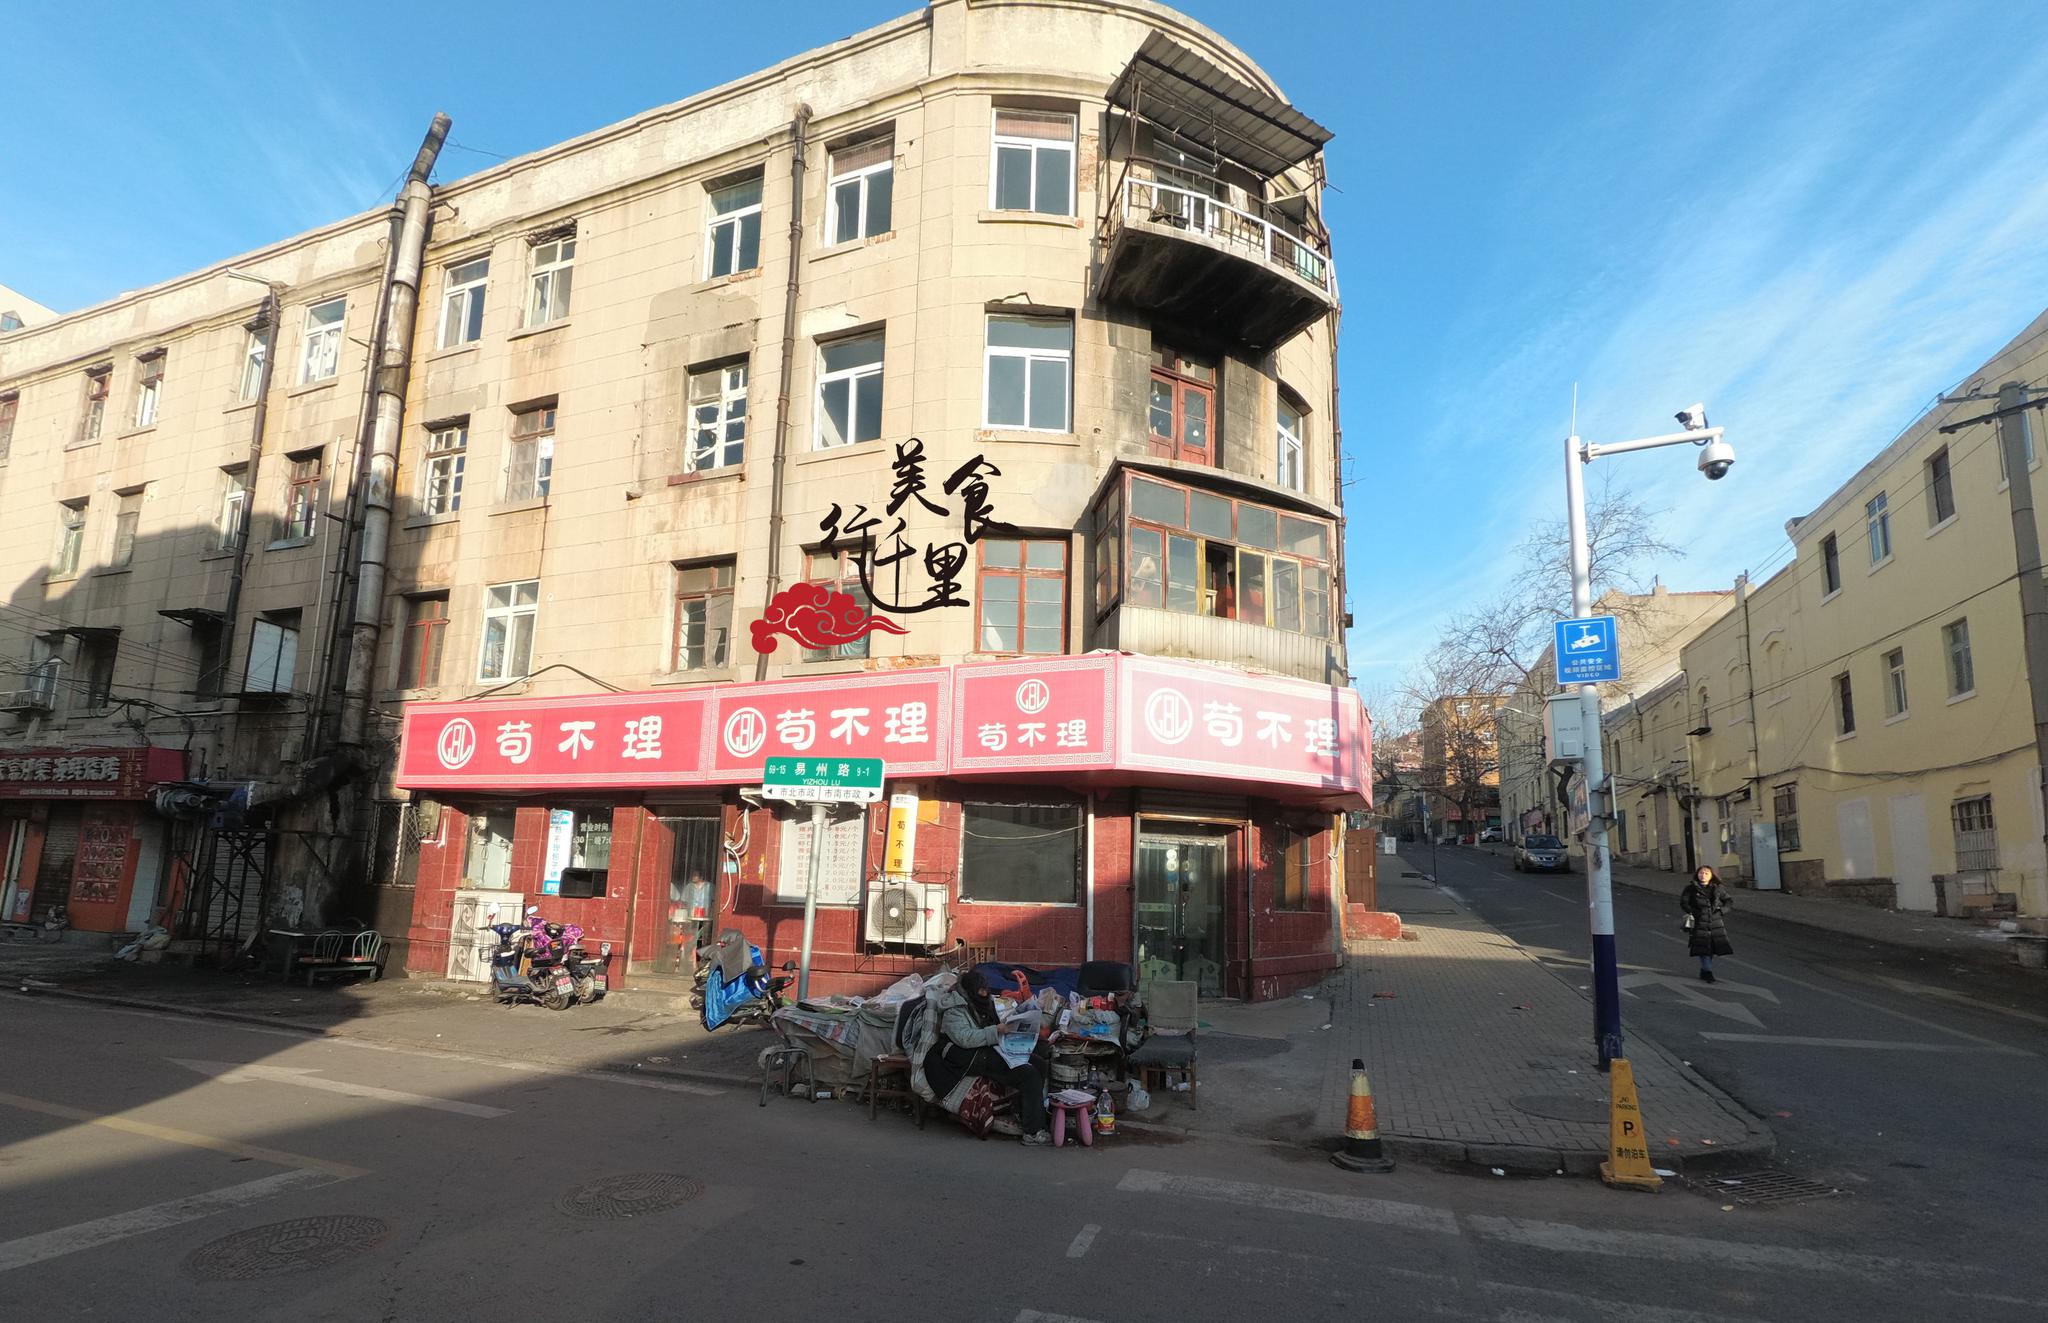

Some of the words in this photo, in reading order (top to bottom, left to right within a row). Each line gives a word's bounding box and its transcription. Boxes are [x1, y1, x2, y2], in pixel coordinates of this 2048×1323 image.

[775, 701, 930, 751] 苟不理
[1203, 701, 1340, 758] 苟不理
[496, 715, 663, 765] 苟不理
[978, 719, 1088, 752] 苟不理
[794, 762, 850, 777] 易州路
[856, 767, 870, 777] 9-1
[802, 778, 828, 786] YIZHOU
[780, 787, 815, 797] 市北市政
[824, 789, 861, 799] 市南市政
[580, 823, 609, 832] 营业时间
[894, 820, 907, 868] 苟不理
[1622, 1121, 1634, 1136] P
